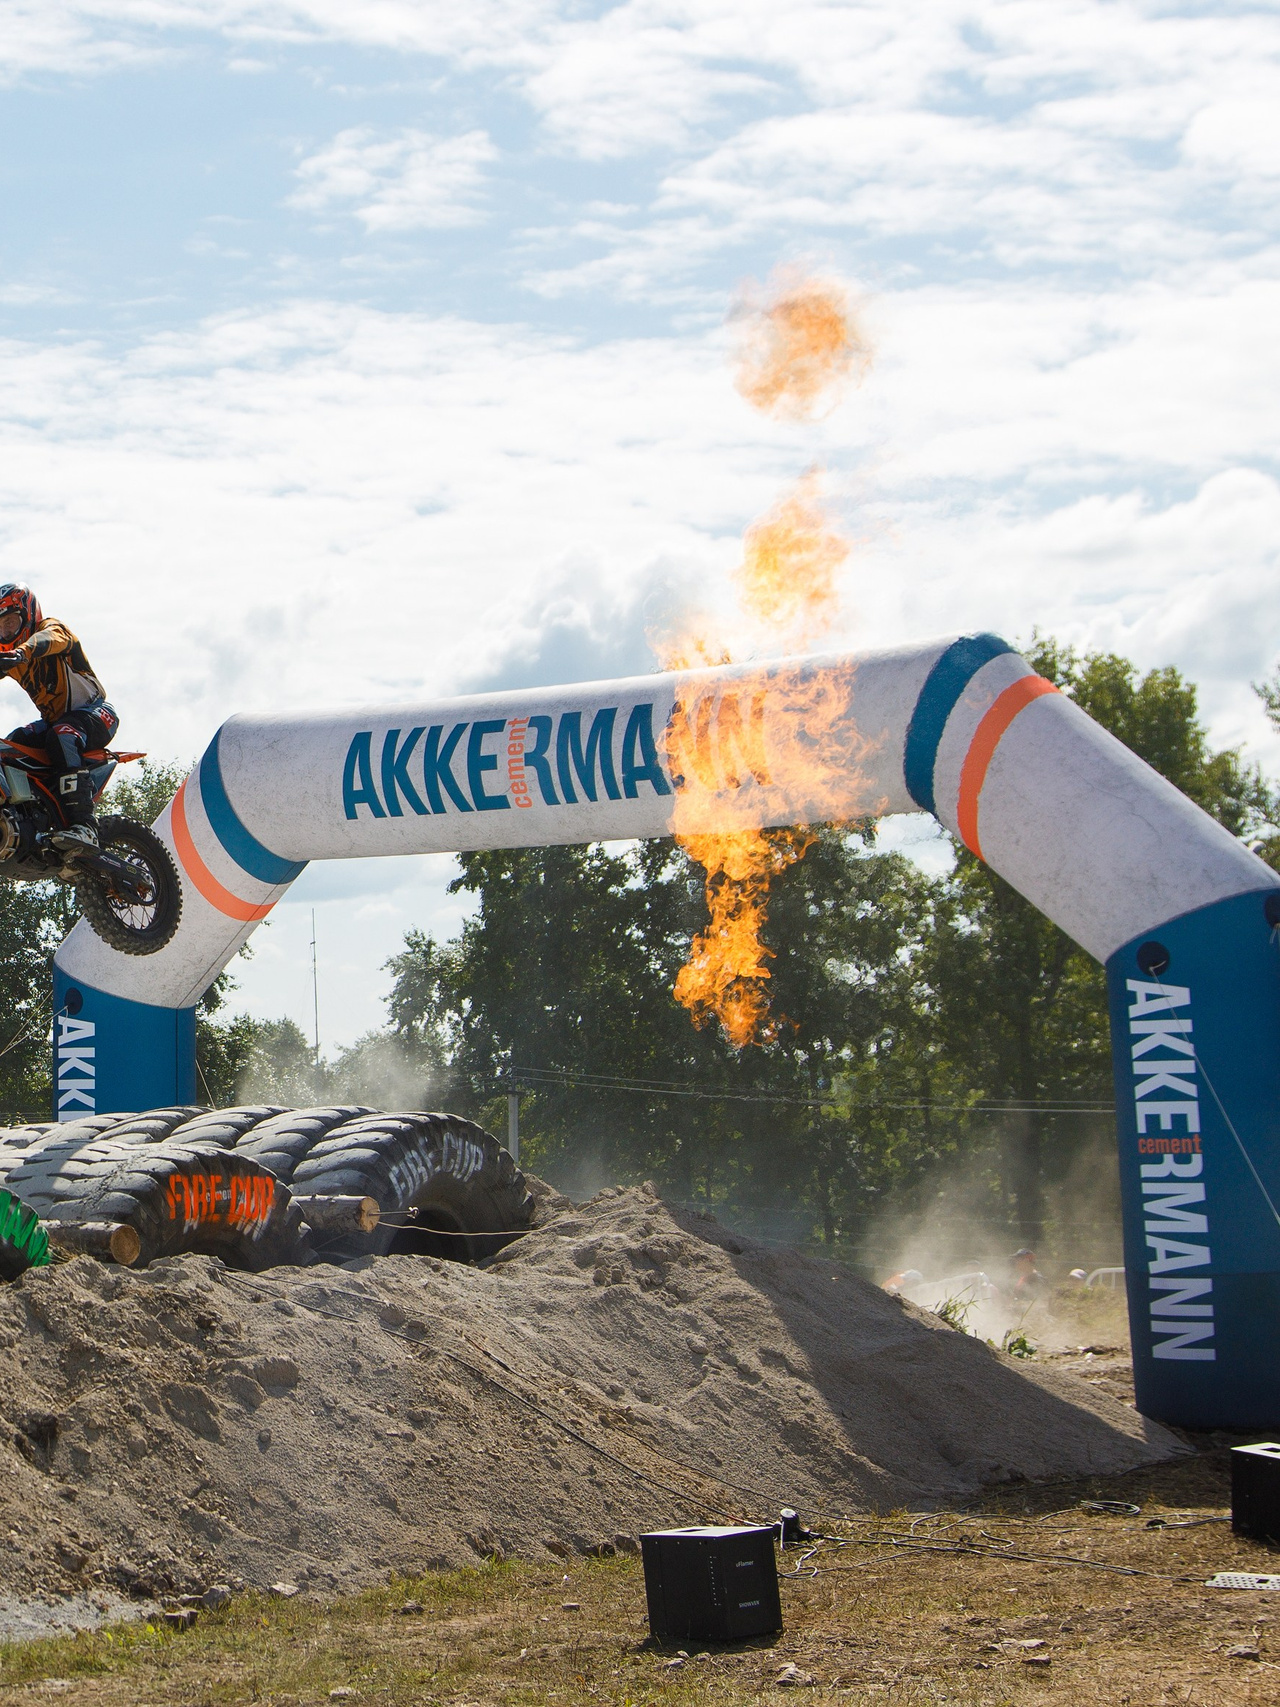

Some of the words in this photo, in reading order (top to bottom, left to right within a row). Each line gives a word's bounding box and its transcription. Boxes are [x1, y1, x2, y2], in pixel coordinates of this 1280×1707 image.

[507, 716, 532, 808] cement
[1126, 979, 1216, 1361] AKKERMANN
[1138, 1133, 1203, 1153] cement
[167, 1175, 222, 1223] FIRE
[228, 1174, 276, 1225] CUP
